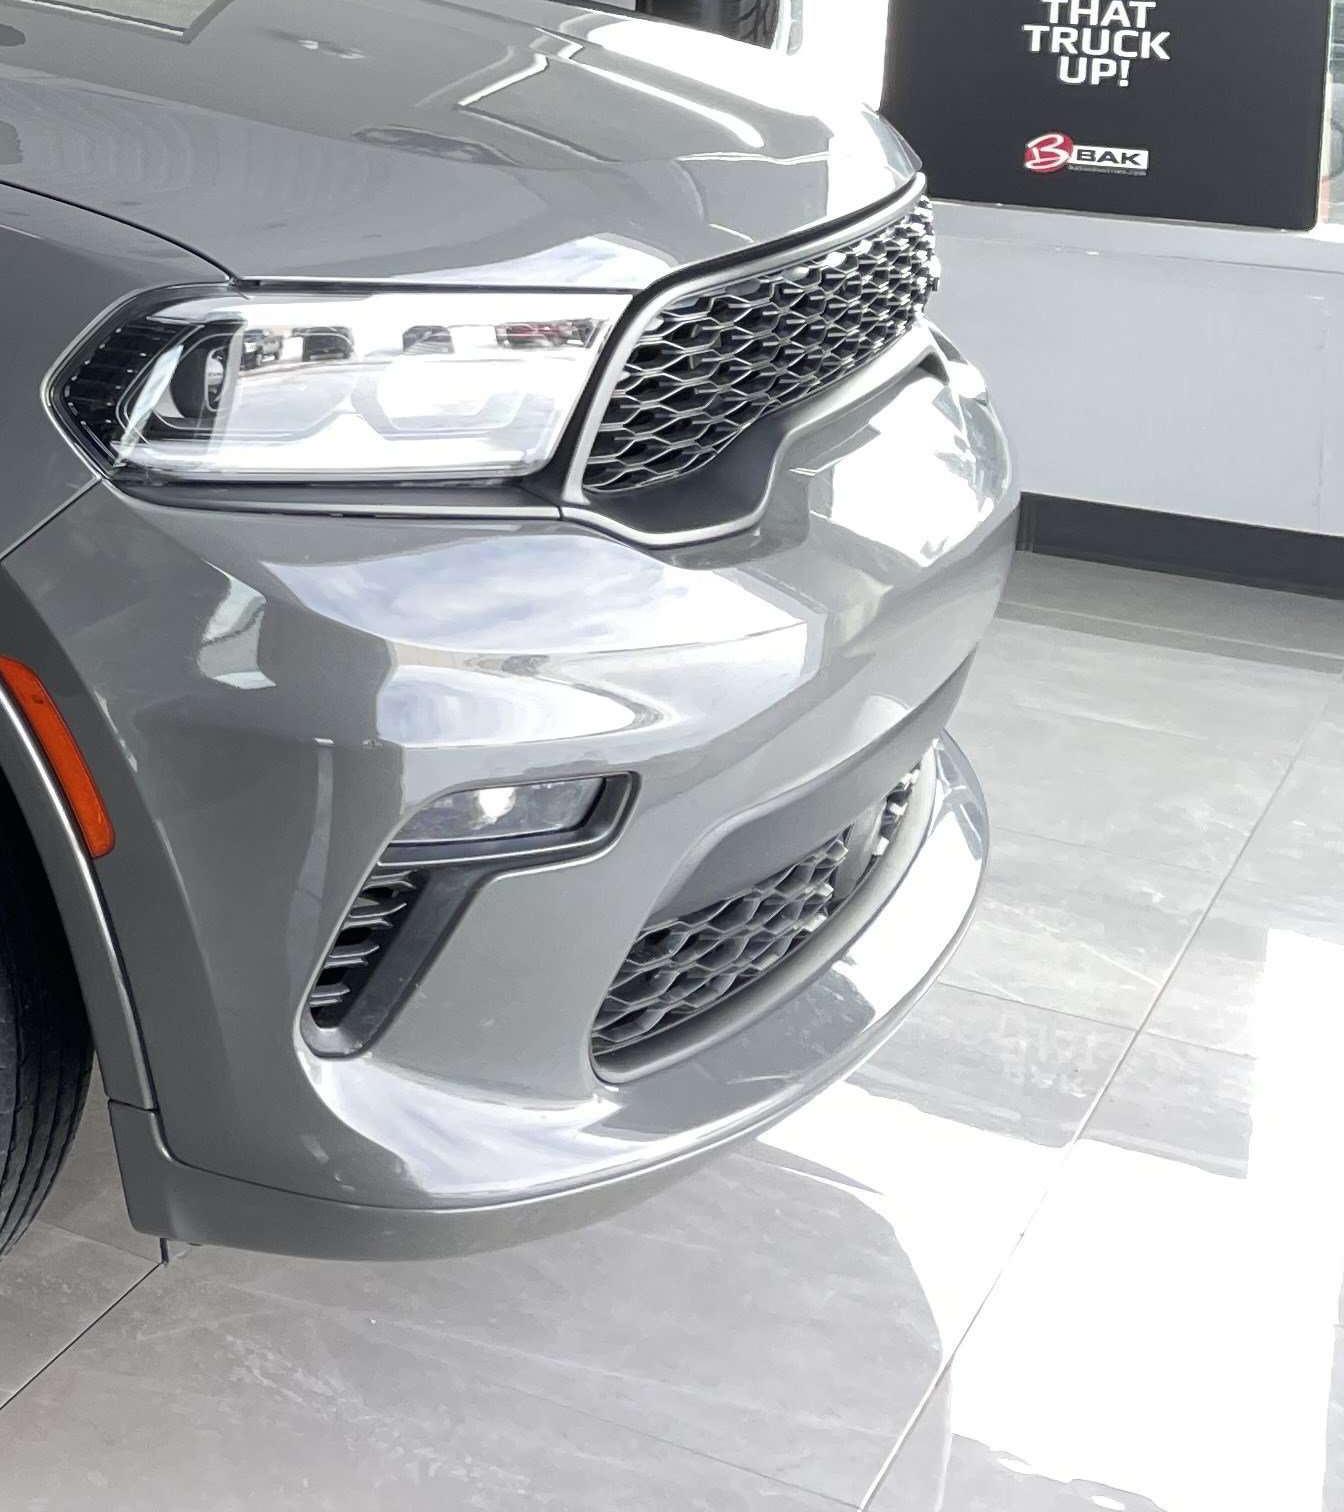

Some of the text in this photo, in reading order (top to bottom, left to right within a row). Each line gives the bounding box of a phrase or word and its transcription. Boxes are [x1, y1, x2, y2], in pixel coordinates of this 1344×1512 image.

[1022, 24, 1171, 60] TRUCK
[1058, 56, 1130, 87] UP!
[1076, 148, 1142, 167] BAK
